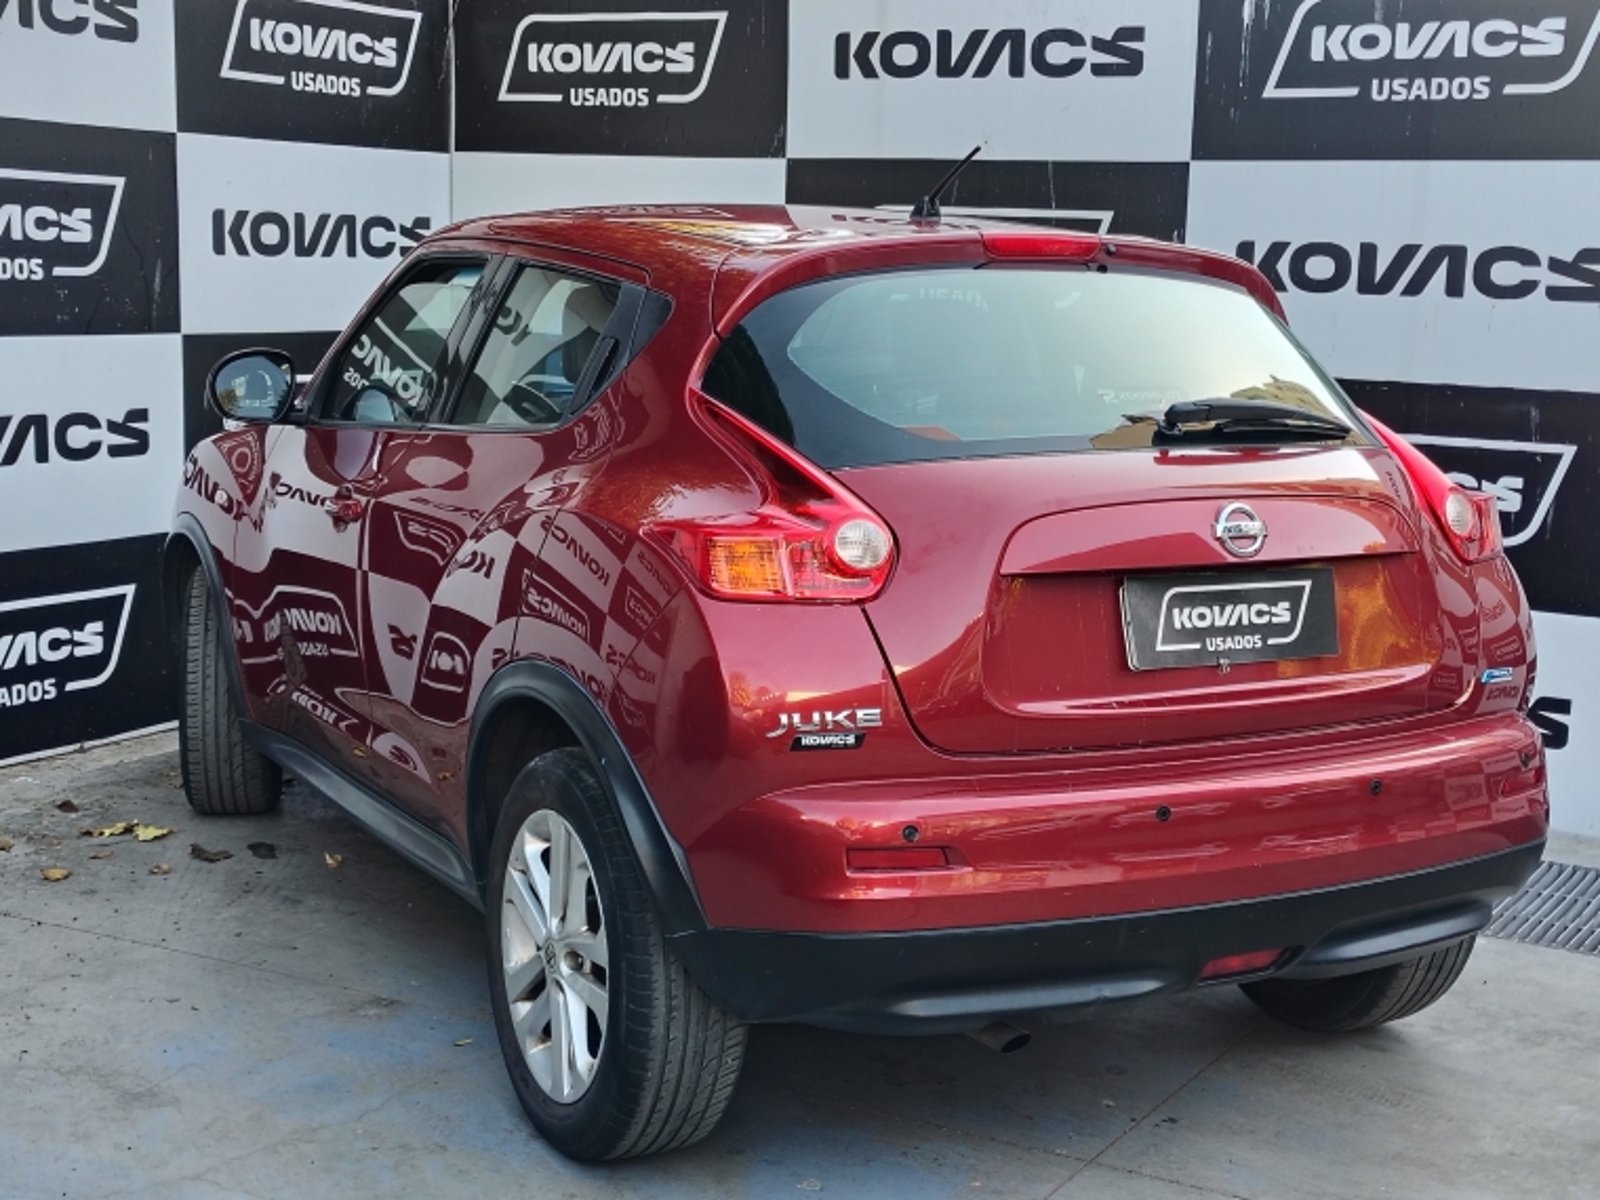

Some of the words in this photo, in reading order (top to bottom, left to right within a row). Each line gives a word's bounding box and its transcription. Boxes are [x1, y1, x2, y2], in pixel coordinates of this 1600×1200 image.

[249, 18, 398, 68] KOVACS
[834, 26, 1146, 79] KOVACS
[1310, 16, 1567, 62] KOVACS
[527, 41, 695, 75] KOVACS
[290, 71, 361, 97] USADOS
[569, 87, 649, 107] USADOS
[1371, 76, 1491, 101] USADOS
[1235, 240, 1600, 302] KOVACS
[1172, 600, 1291, 630] KOVACS
[1205, 634, 1263, 652] USADOS
[765, 707, 884, 738] JUKE
